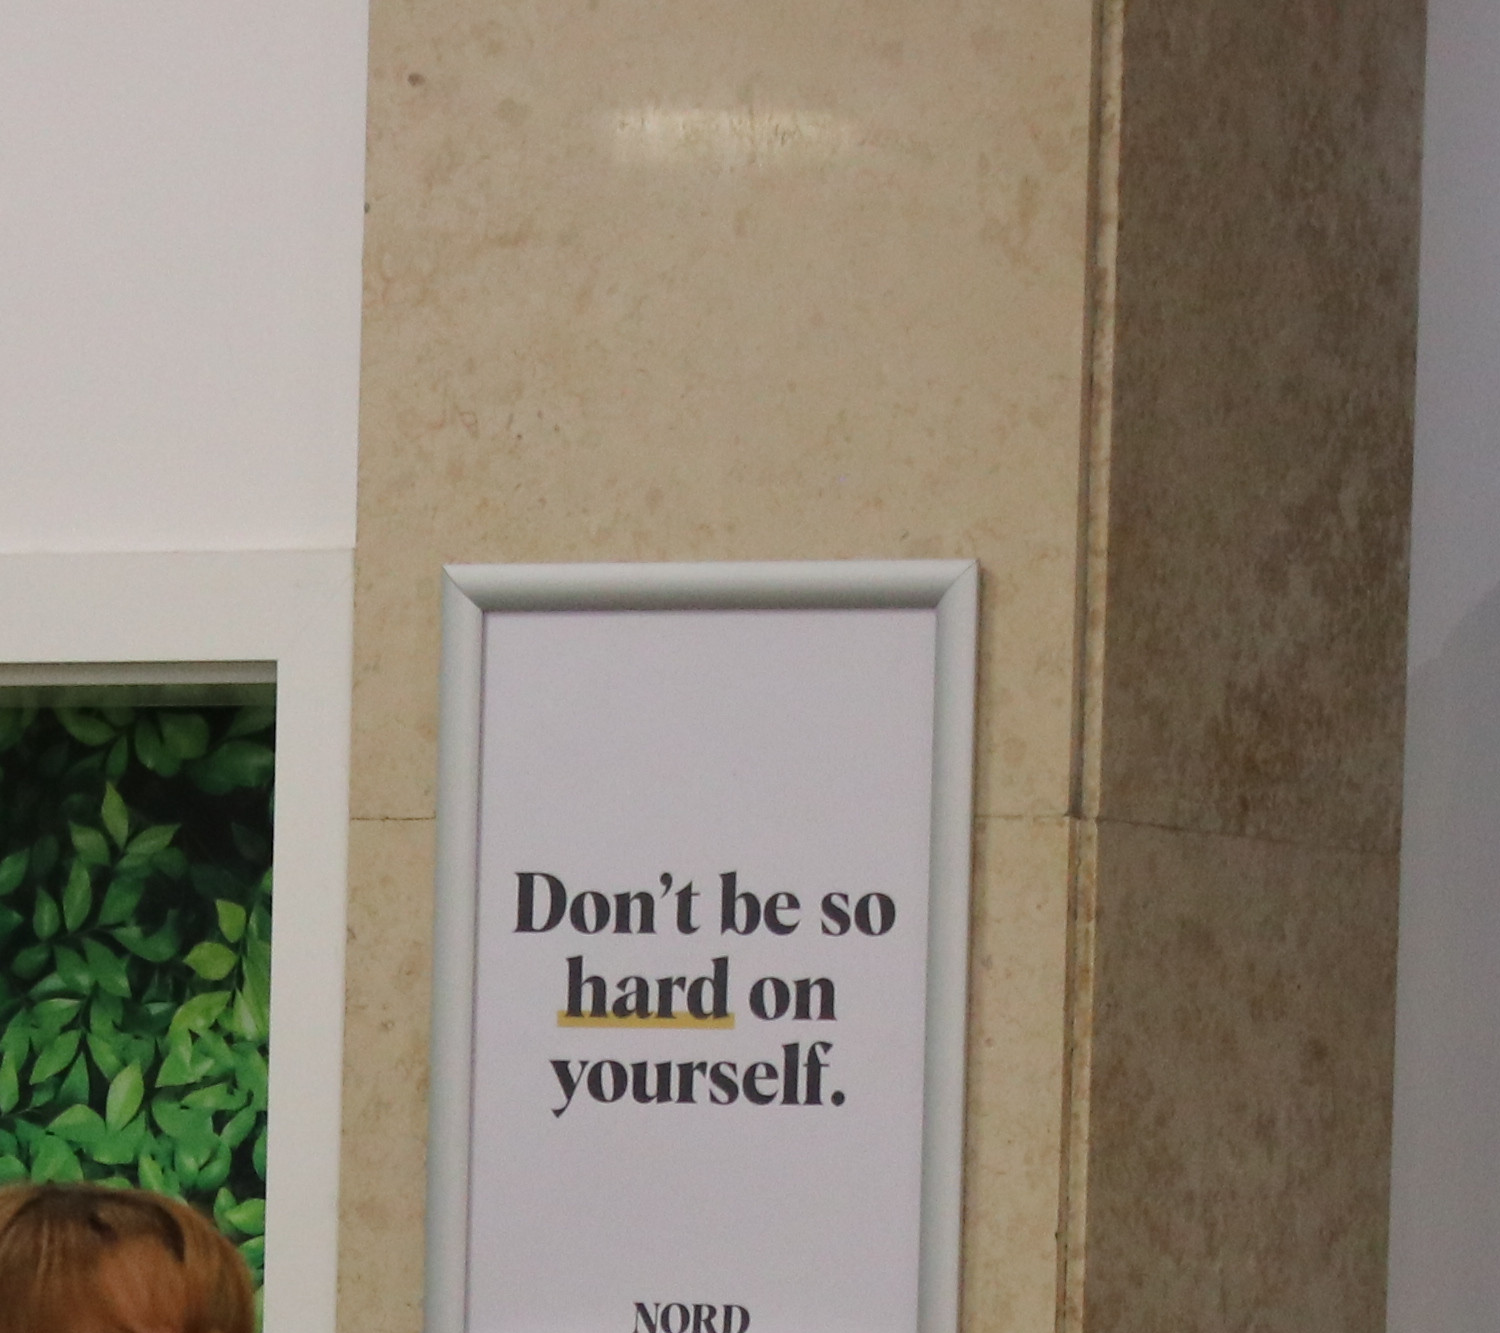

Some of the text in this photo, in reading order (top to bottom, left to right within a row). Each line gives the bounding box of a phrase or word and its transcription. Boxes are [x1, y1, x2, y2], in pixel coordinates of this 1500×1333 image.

[513, 869, 896, 938] Don't be so
[566, 956, 837, 1022] hard on
[551, 1041, 846, 1119] yourself.
